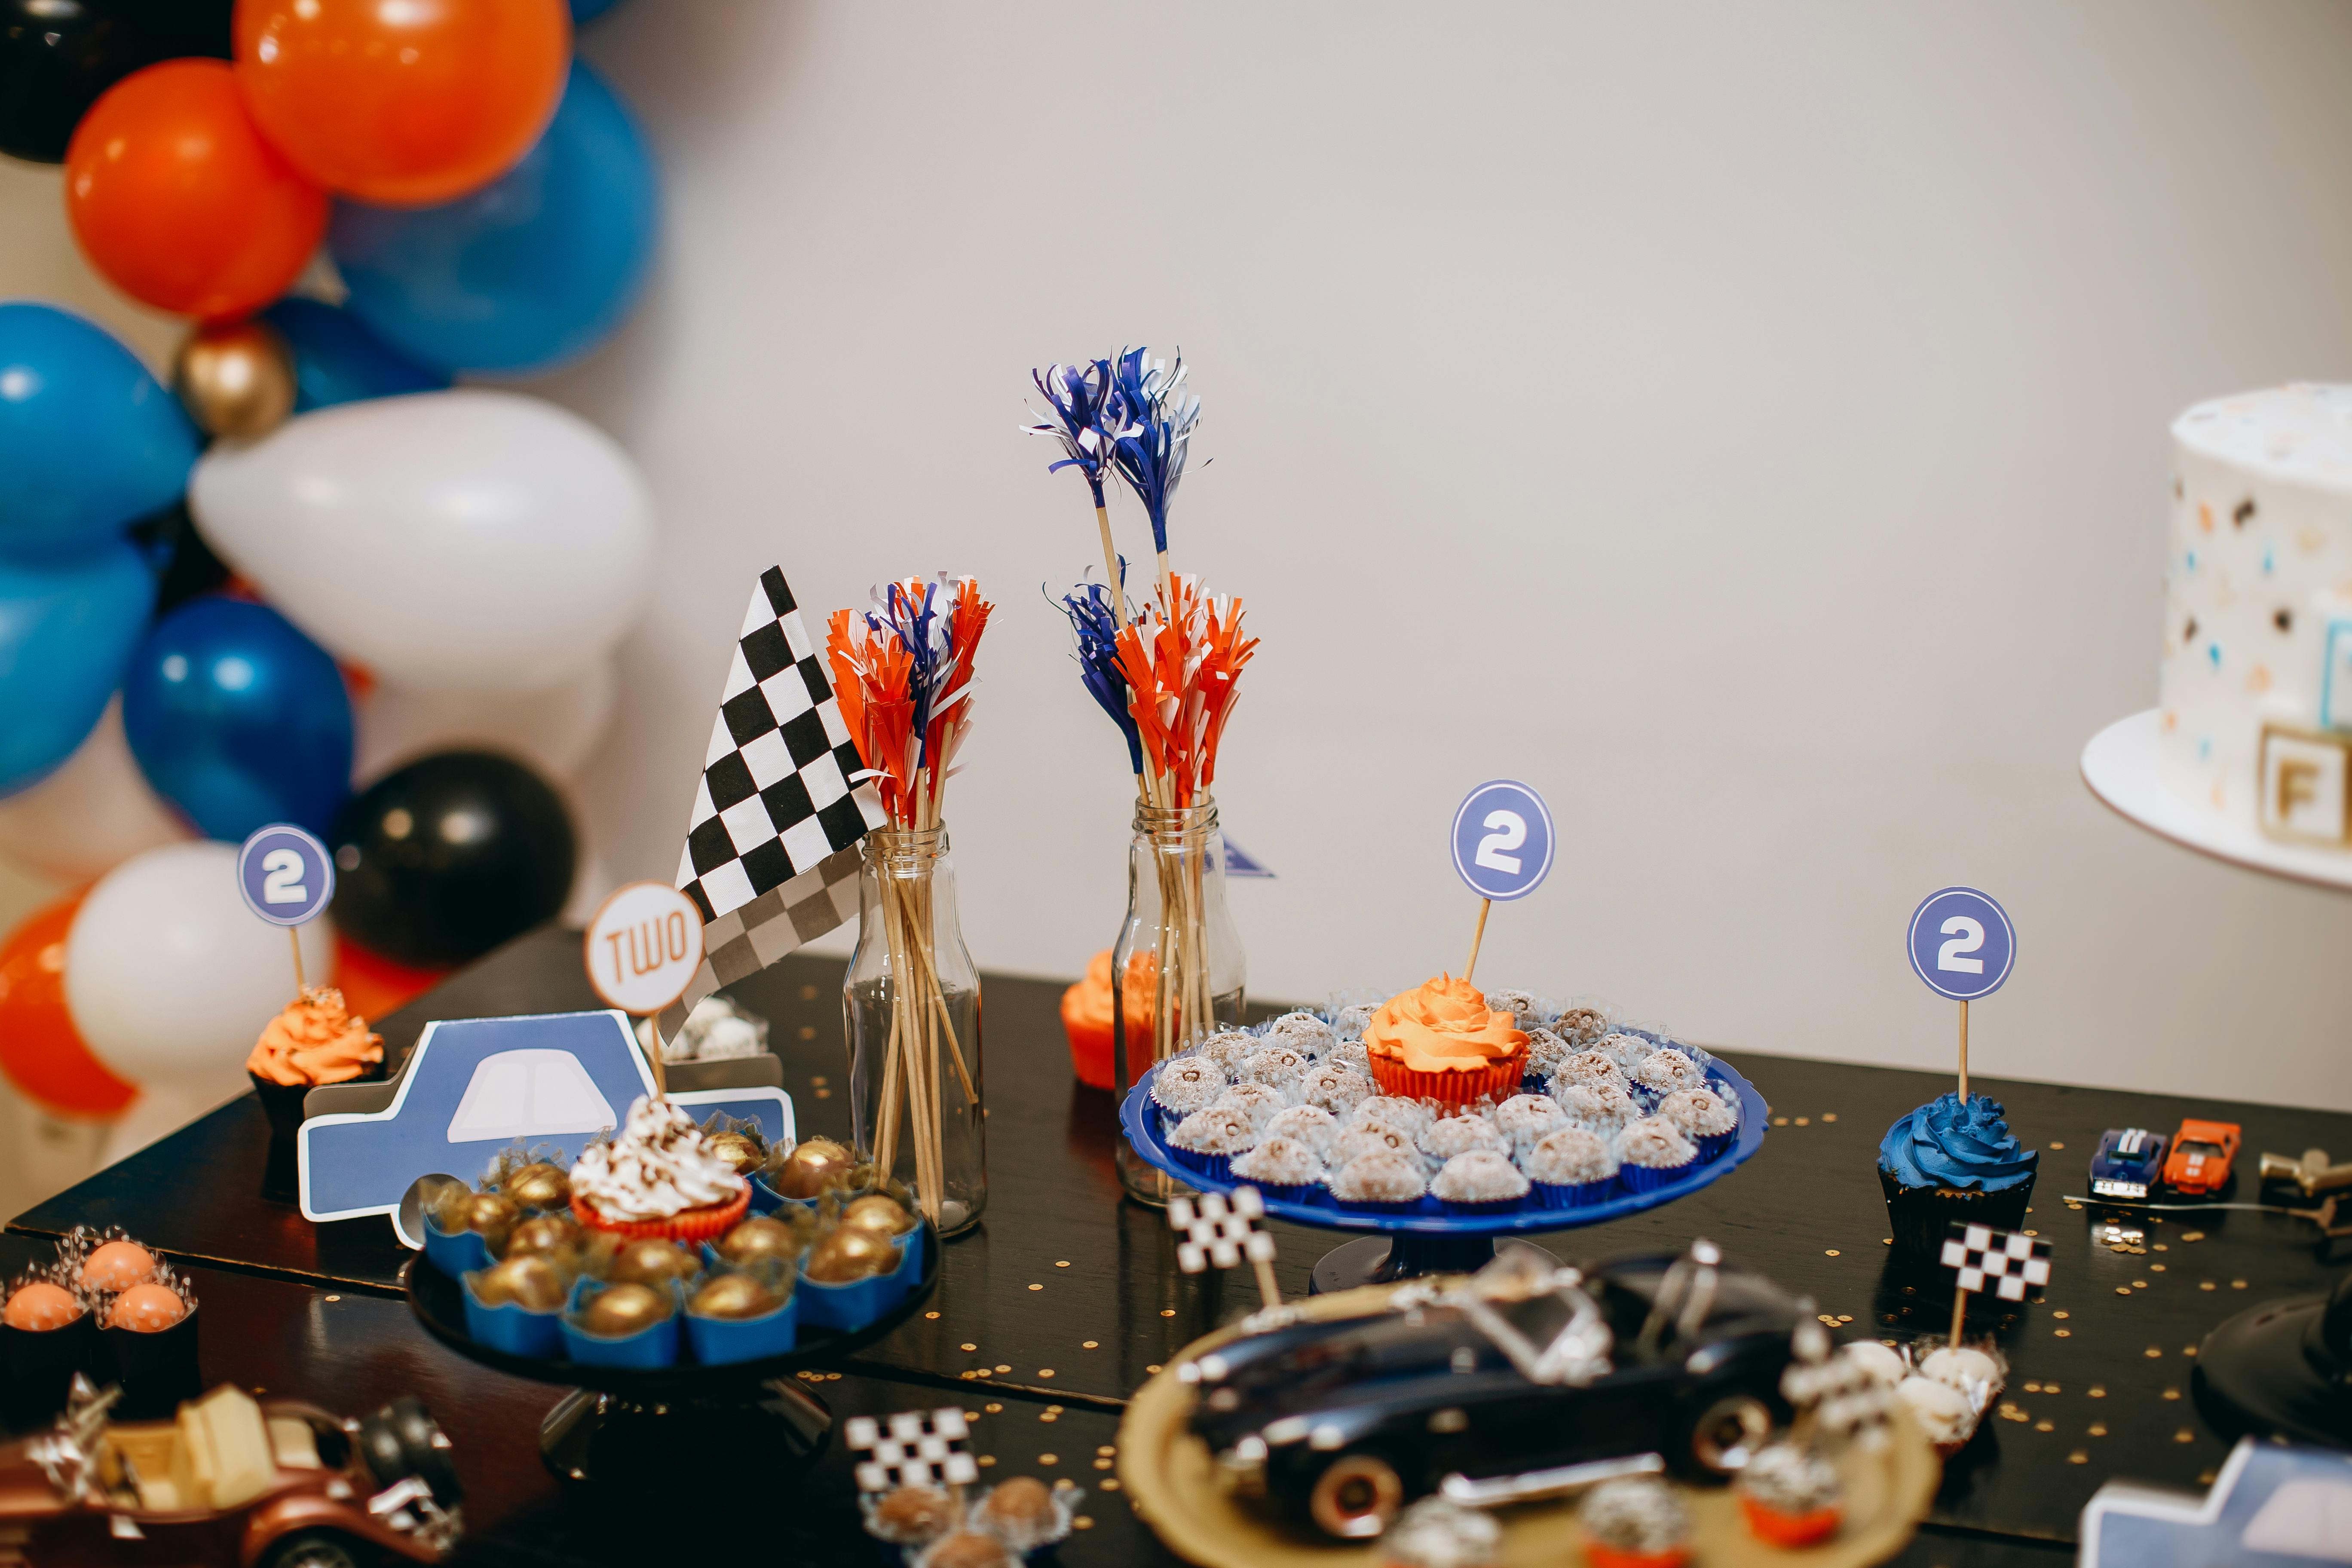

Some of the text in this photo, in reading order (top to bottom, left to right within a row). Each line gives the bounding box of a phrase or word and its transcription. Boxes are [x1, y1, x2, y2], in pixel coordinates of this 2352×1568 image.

[1475, 810, 1527, 874] 2
[263, 848, 307, 904] 2
[605, 910, 686, 985] TWO
[1938, 916, 1985, 974] 2
